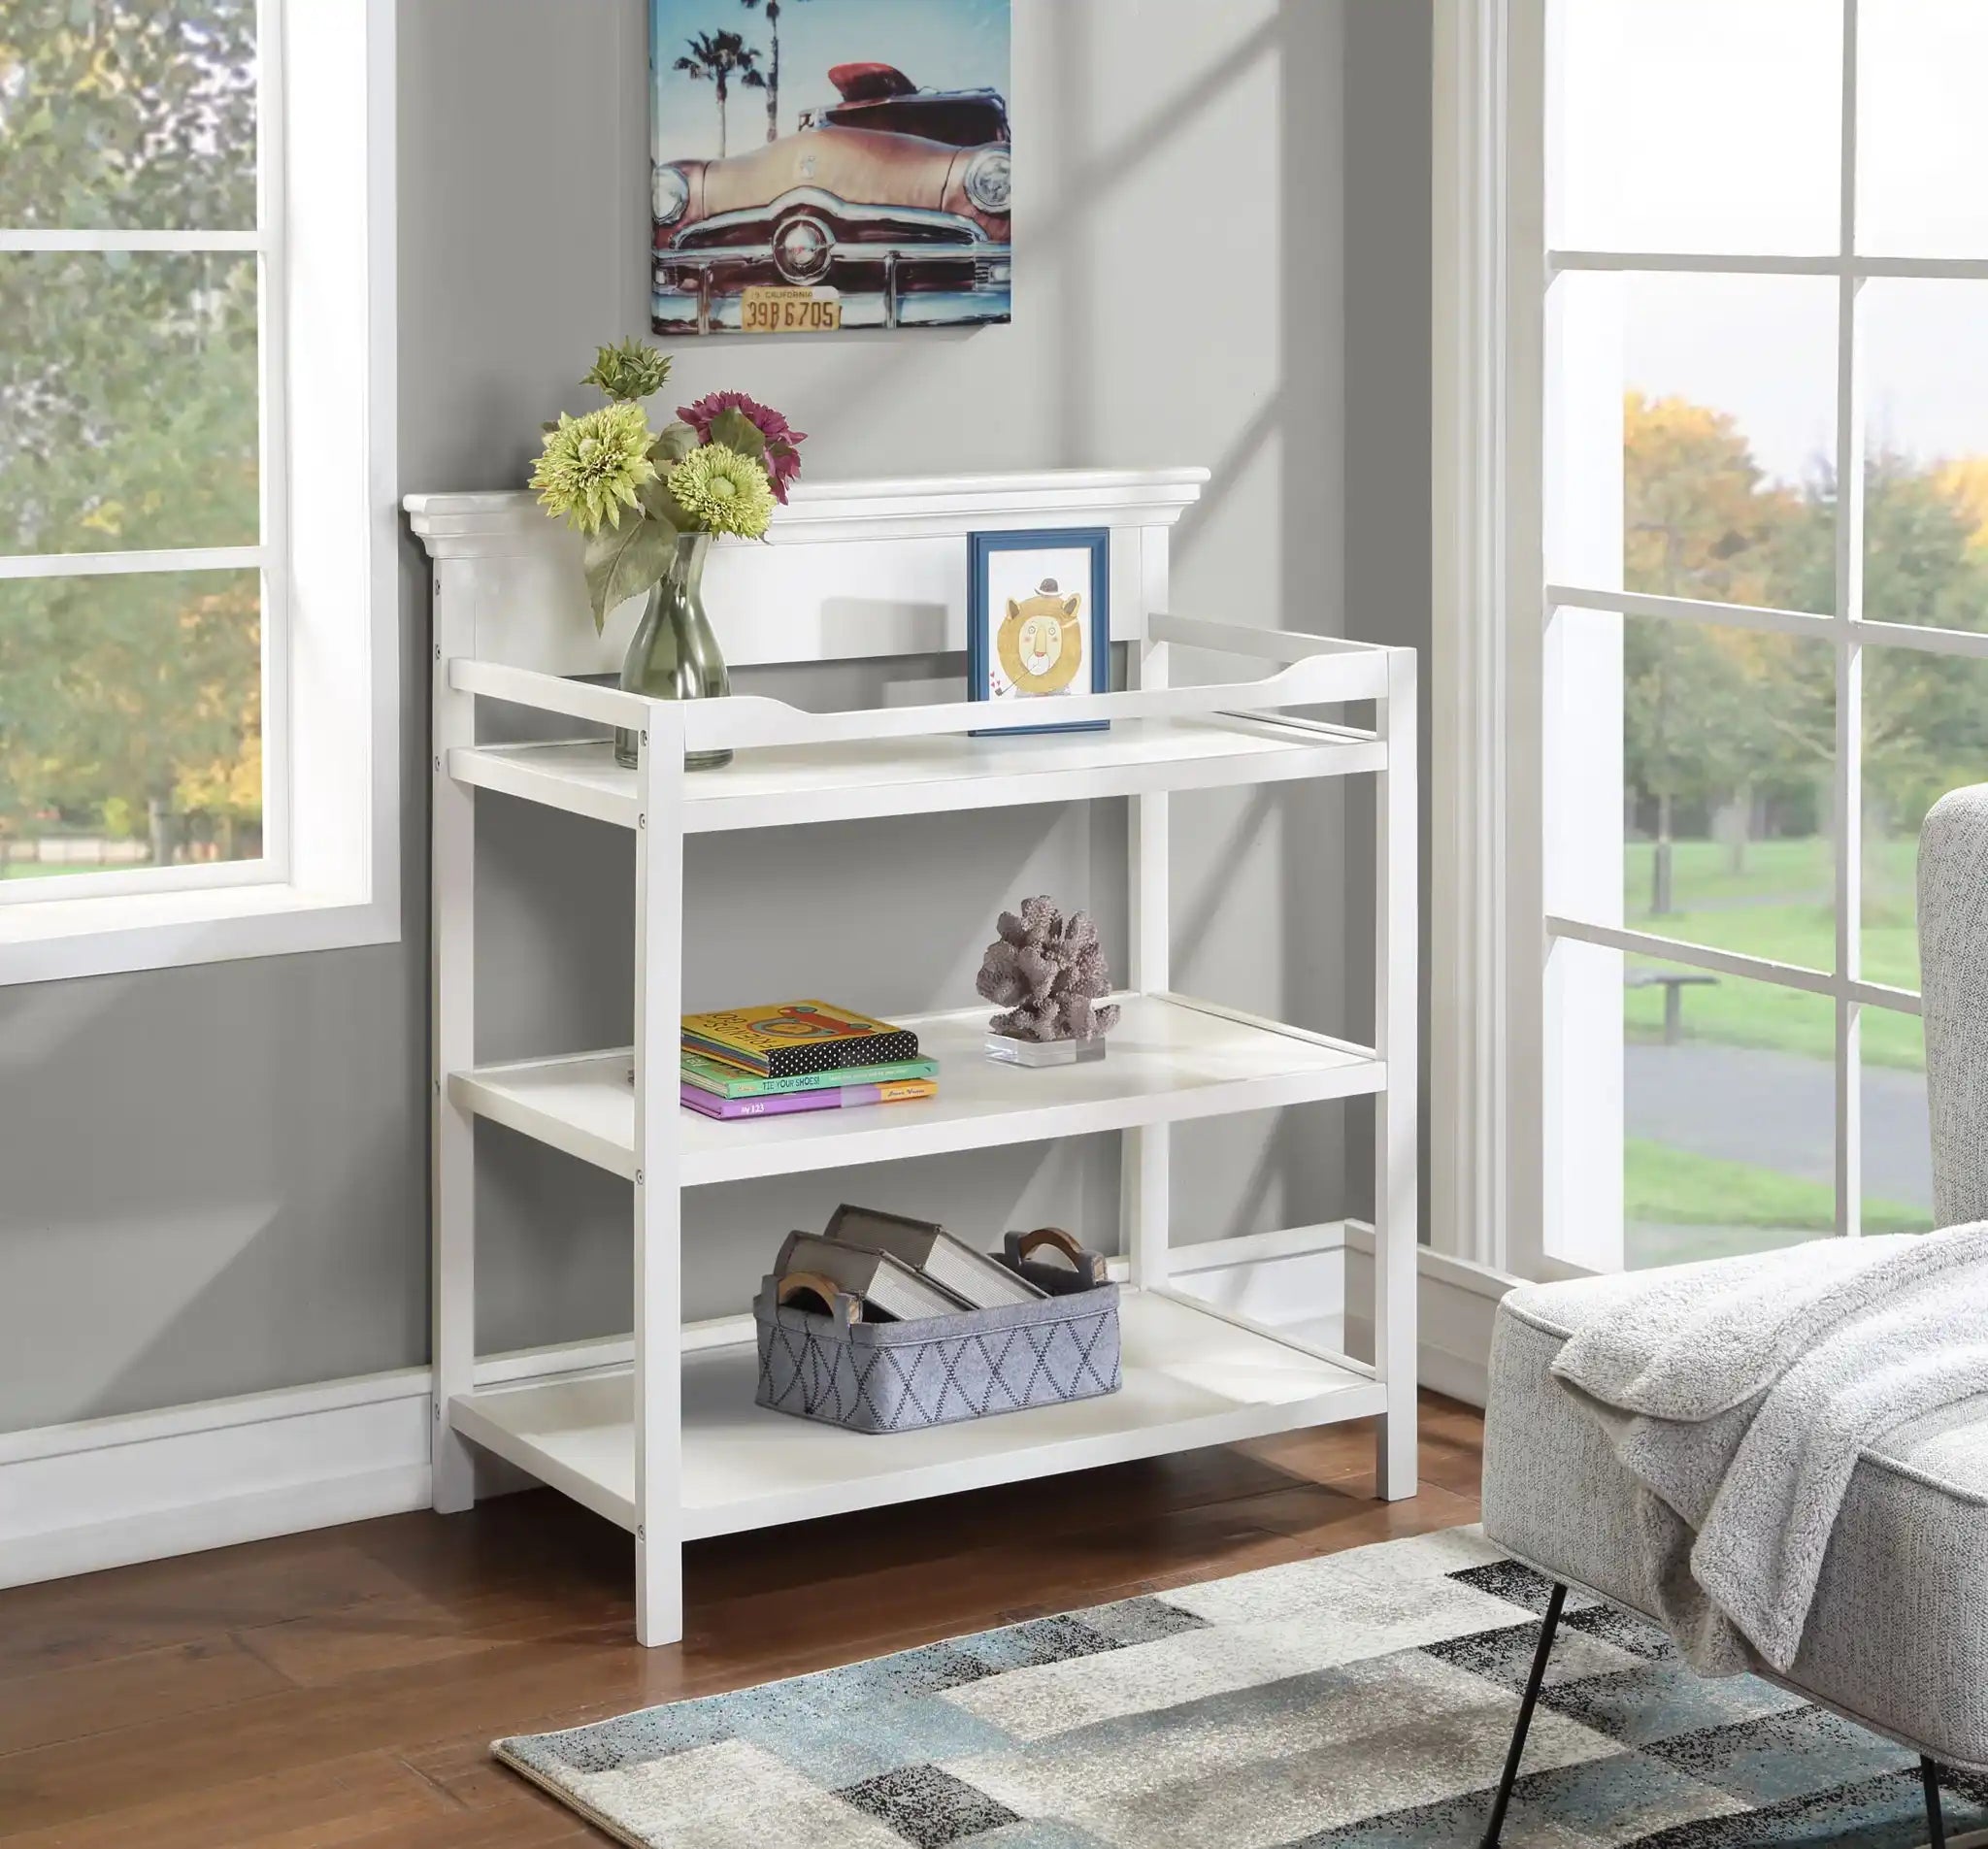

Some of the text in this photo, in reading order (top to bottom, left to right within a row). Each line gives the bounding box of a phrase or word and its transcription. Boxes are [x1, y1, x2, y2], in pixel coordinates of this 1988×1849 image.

[763, 1080, 775, 1090] TIE
[777, 1078, 794, 1088] YOUR
[751, 1103, 764, 1112] 123
